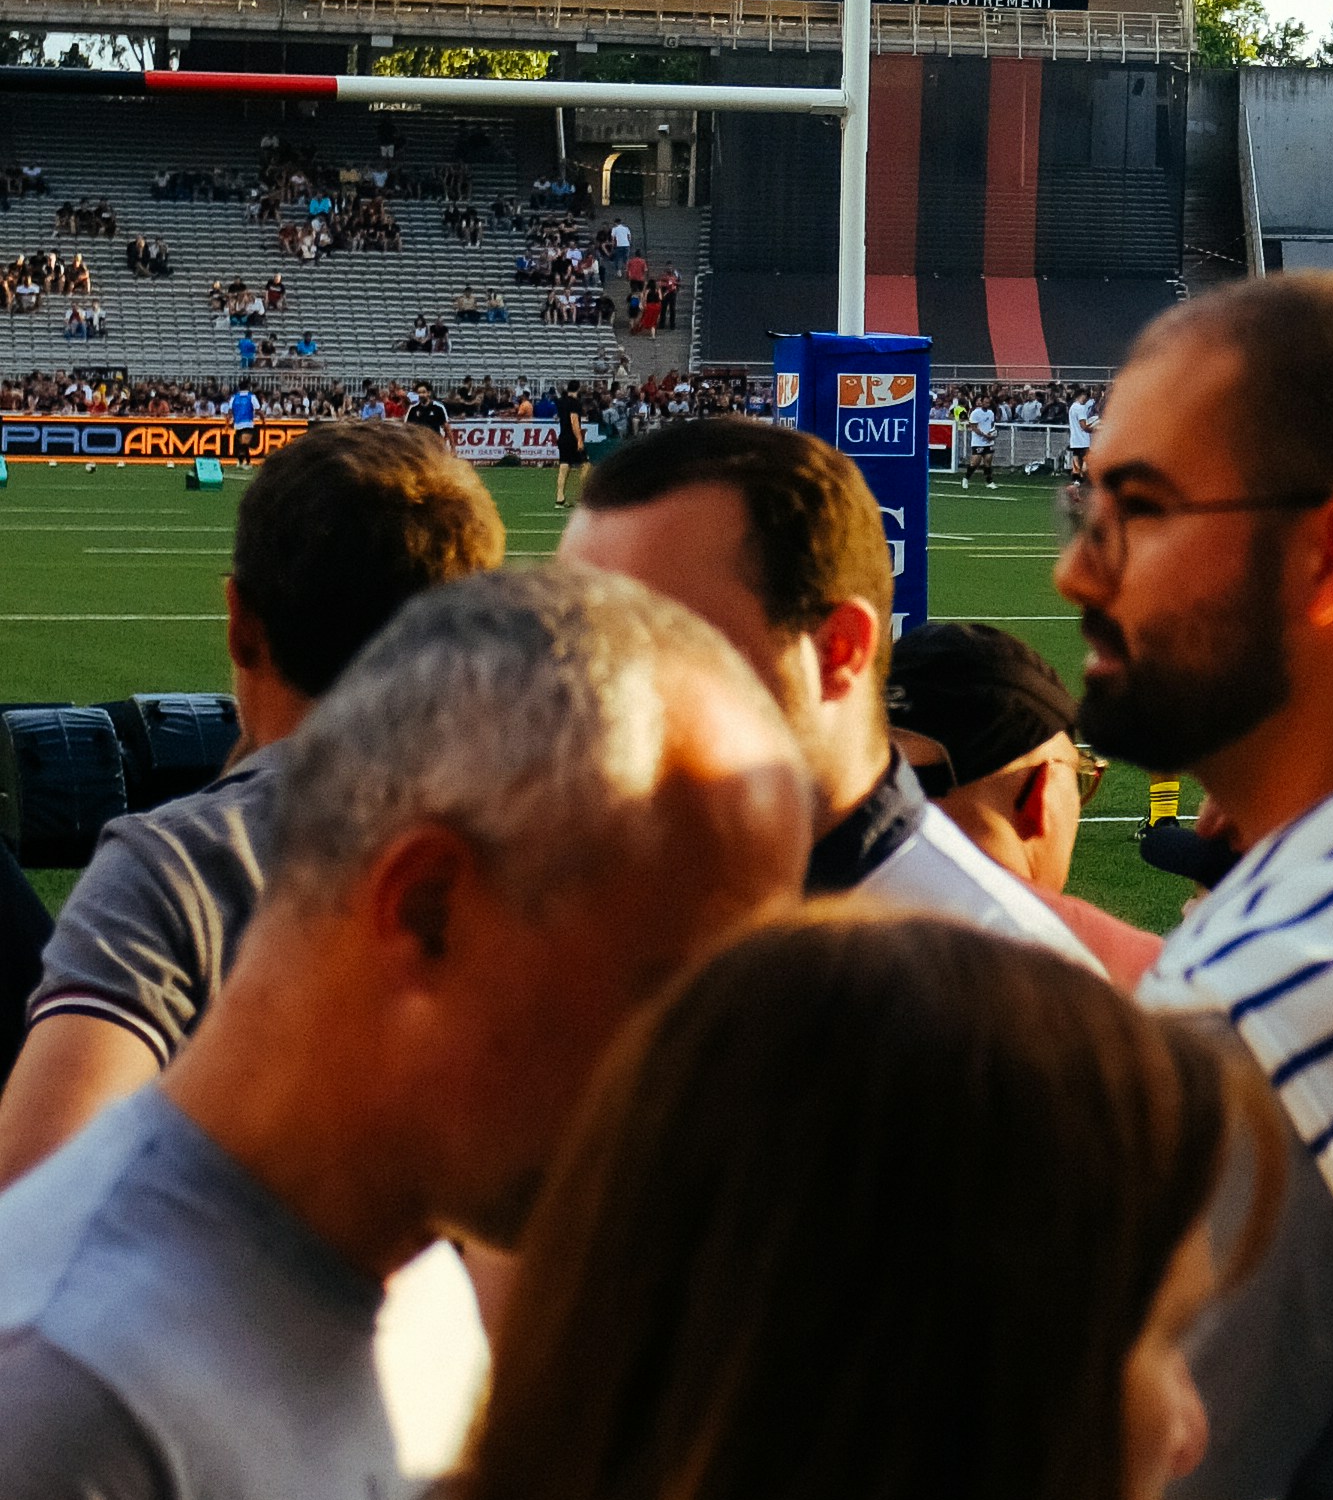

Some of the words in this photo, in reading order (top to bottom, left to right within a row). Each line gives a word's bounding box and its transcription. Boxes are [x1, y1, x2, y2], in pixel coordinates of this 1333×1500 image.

[2, 426, 122, 454] PRO
[450, 427, 515, 447] EGIE
[844, 417, 909, 444] GMF
